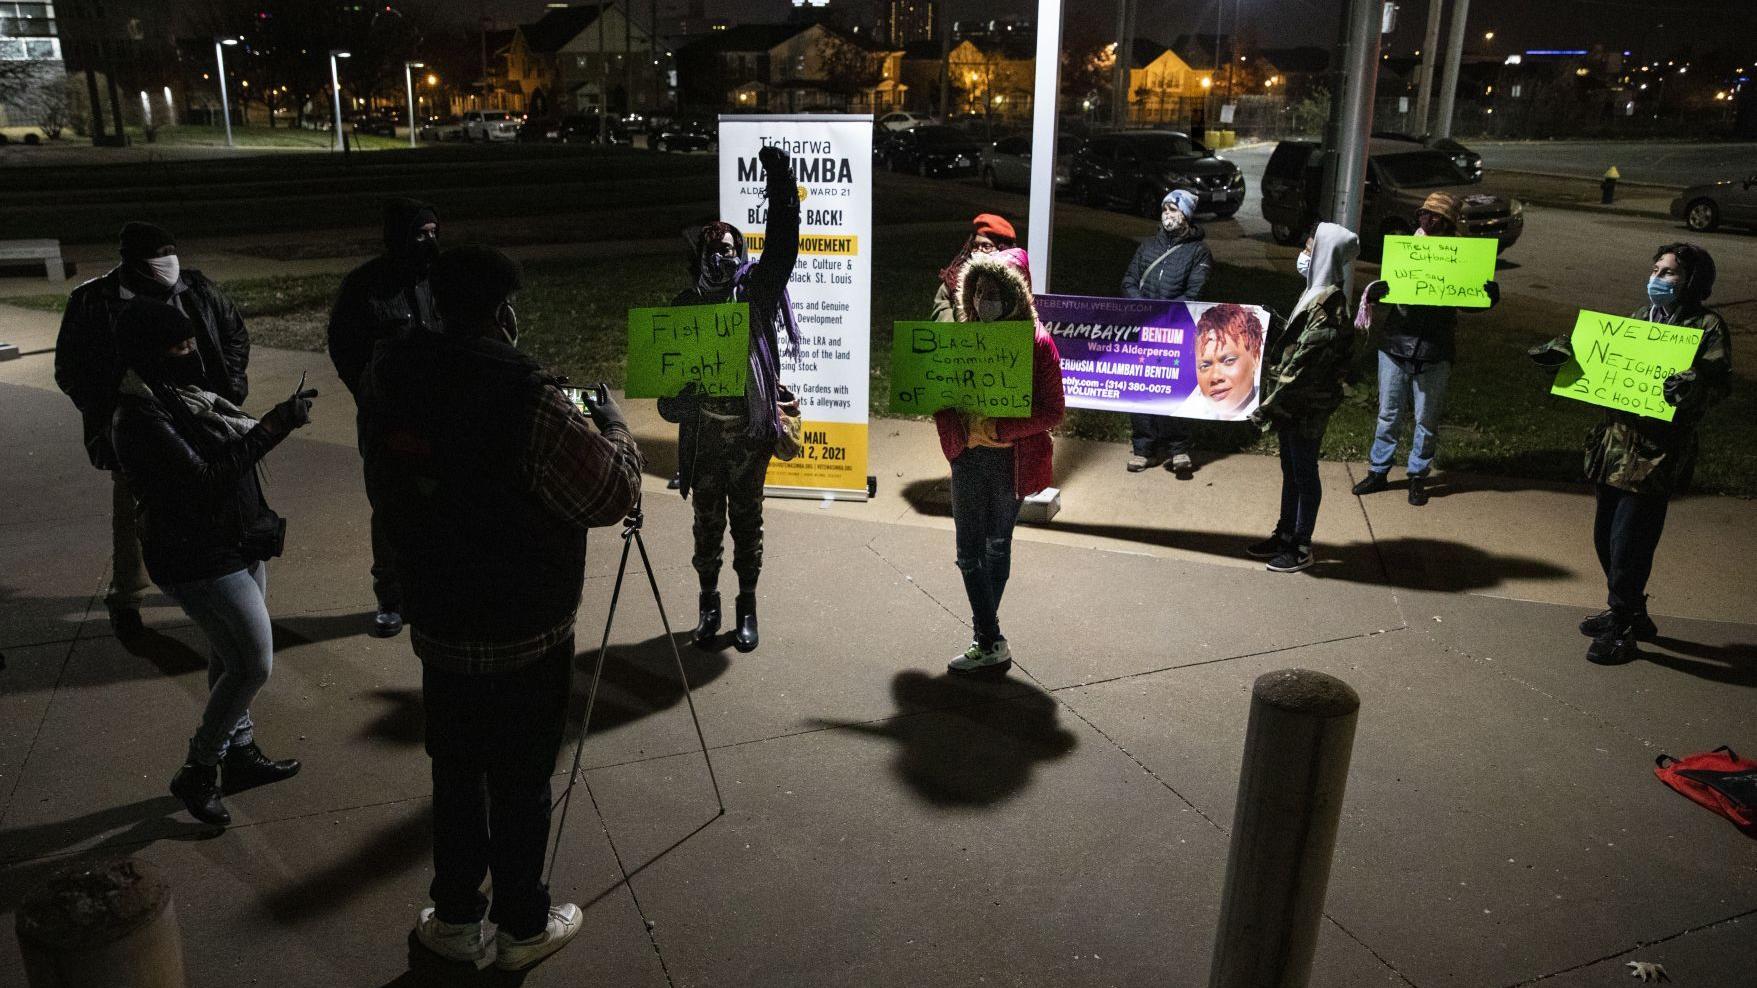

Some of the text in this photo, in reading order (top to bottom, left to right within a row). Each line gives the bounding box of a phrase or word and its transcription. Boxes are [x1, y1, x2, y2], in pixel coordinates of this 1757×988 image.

[810, 188, 851, 197] WARD 21
[806, 209, 843, 226] BACK!
[798, 238, 852, 253] MOVEMENT
[794, 258, 853, 270] the Culture &
[789, 272, 852, 285] Black St. Louis
[1394, 269, 1423, 280] WE
[1415, 280, 1485, 299] PAYBACK
[806, 301, 819, 310] and
[821, 301, 850, 311] Genuine
[797, 314, 843, 326] Development
[1141, 326, 1185, 345] BENTUM
[1598, 319, 1699, 346] WE DEMAND
[813, 336, 826, 346] LRA
[828, 337, 842, 346] and
[811, 349, 819, 358] of
[821, 349, 833, 359] the
[835, 350, 850, 360] land
[1087, 342, 1180, 357] Ward 3 Alderperson
[662, 349, 725, 381] Fight
[1095, 361, 1143, 377] KALAMBAYI
[1144, 364, 1180, 380] BENTUM
[803, 384, 831, 394] Gardens
[833, 385, 849, 394] with
[1105, 379, 1127, 391] (314)
[1127, 382, 1172, 394] 380-0075
[1602, 370, 1662, 397] HOOD
[1066, 386, 1120, 399] VOLUNTEER
[1573, 377, 1666, 414] SCHOOLS
[809, 397, 815, 405] &
[816, 398, 851, 408] alleyways
[803, 432, 828, 444] MAIL
[808, 446, 818, 460] 2,
[822, 446, 846, 460] 2021
